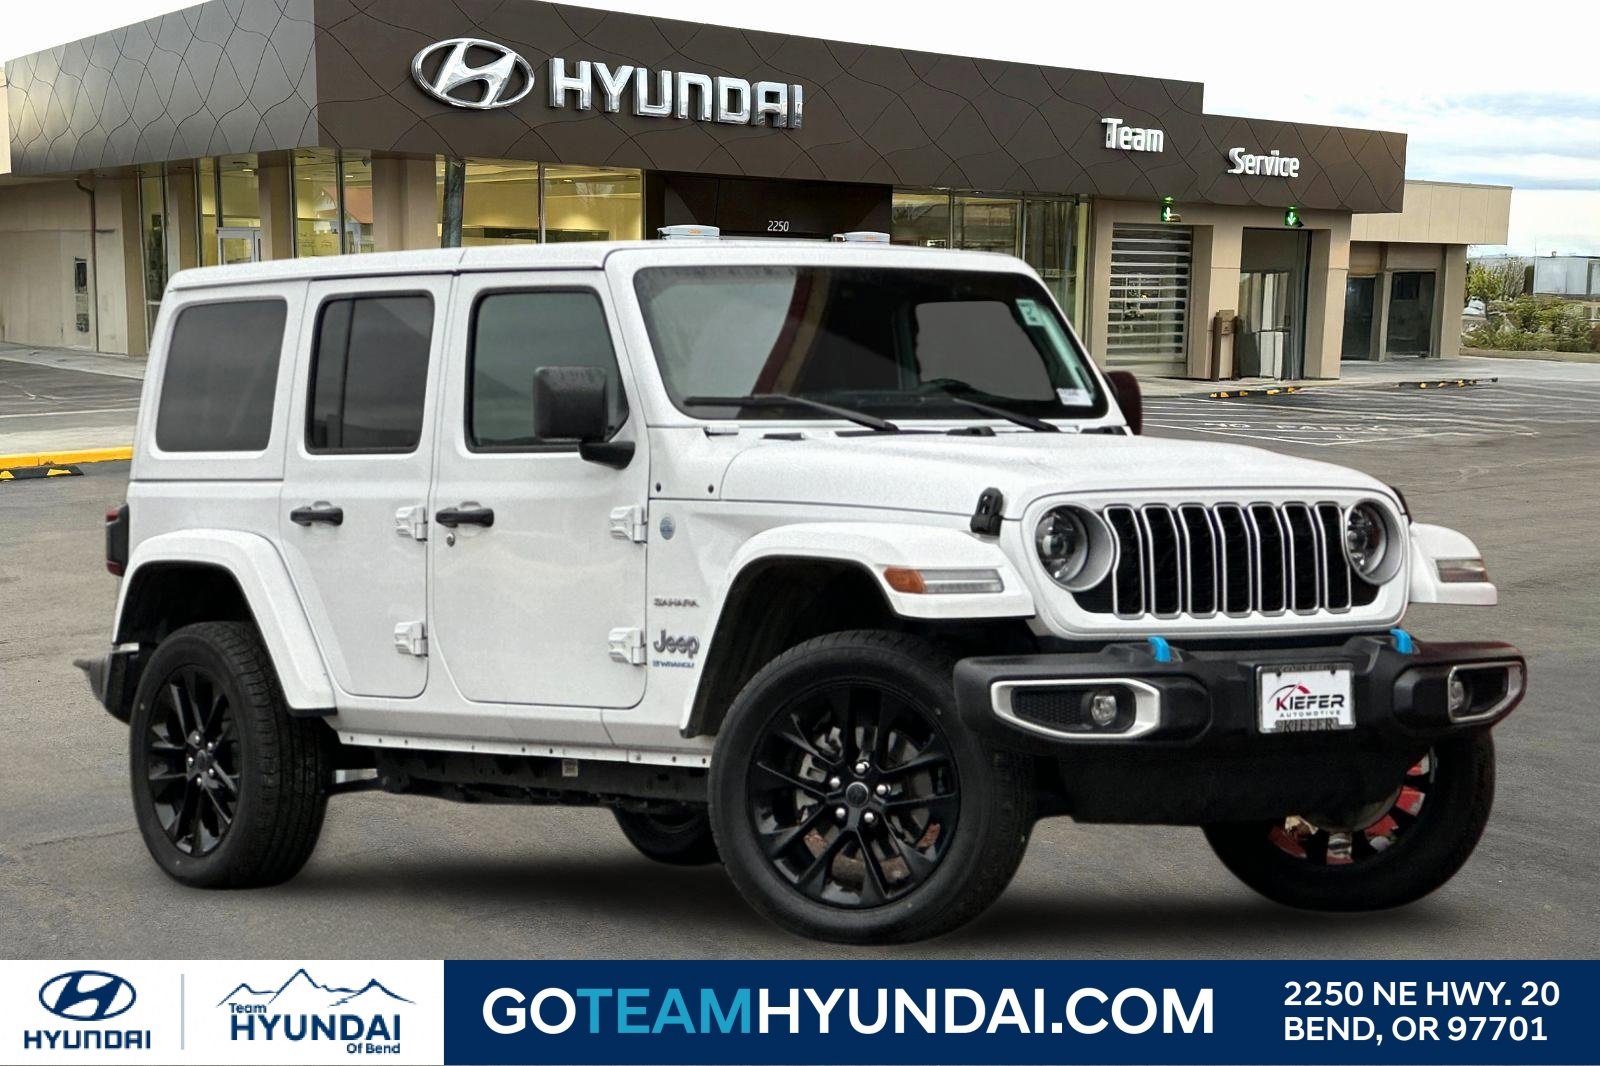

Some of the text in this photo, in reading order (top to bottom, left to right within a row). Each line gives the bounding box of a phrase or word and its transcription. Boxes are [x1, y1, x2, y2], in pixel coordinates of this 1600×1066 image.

[549, 57, 803, 129] HYUNDAI
[1101, 117, 1164, 152] Team
[1227, 147, 1300, 178] Service
[767, 220, 790, 232] 2250
[653, 598, 699, 608] SAHARA
[653, 629, 700, 659] Jeep
[1276, 694, 1345, 711] KIEFER
[1280, 710, 1340, 718] AUTOMOTIVE
